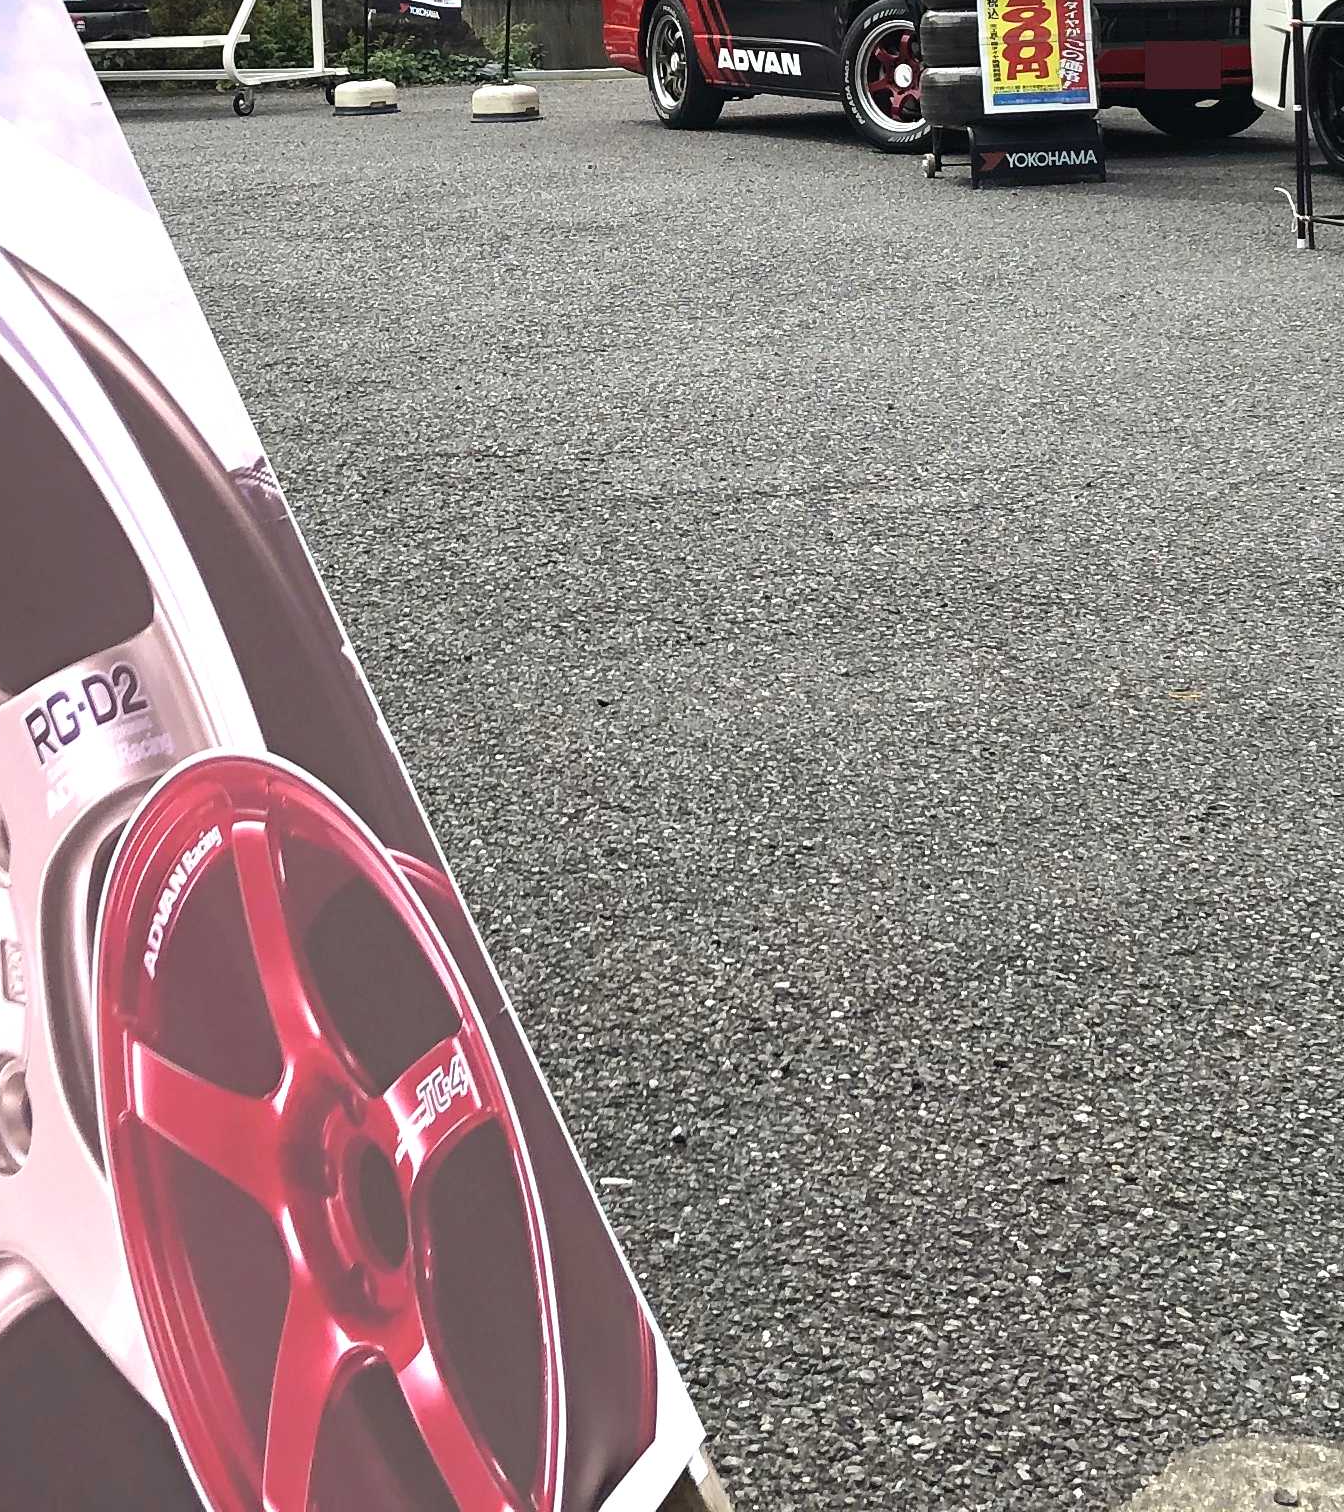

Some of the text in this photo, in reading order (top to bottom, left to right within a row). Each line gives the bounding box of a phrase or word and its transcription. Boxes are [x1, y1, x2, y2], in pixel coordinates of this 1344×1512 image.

[717, 47, 802, 77] ADVAN
[1005, 149, 1098, 168] YOKOHAMA
[143, 824, 223, 981] ADVAN Racing
